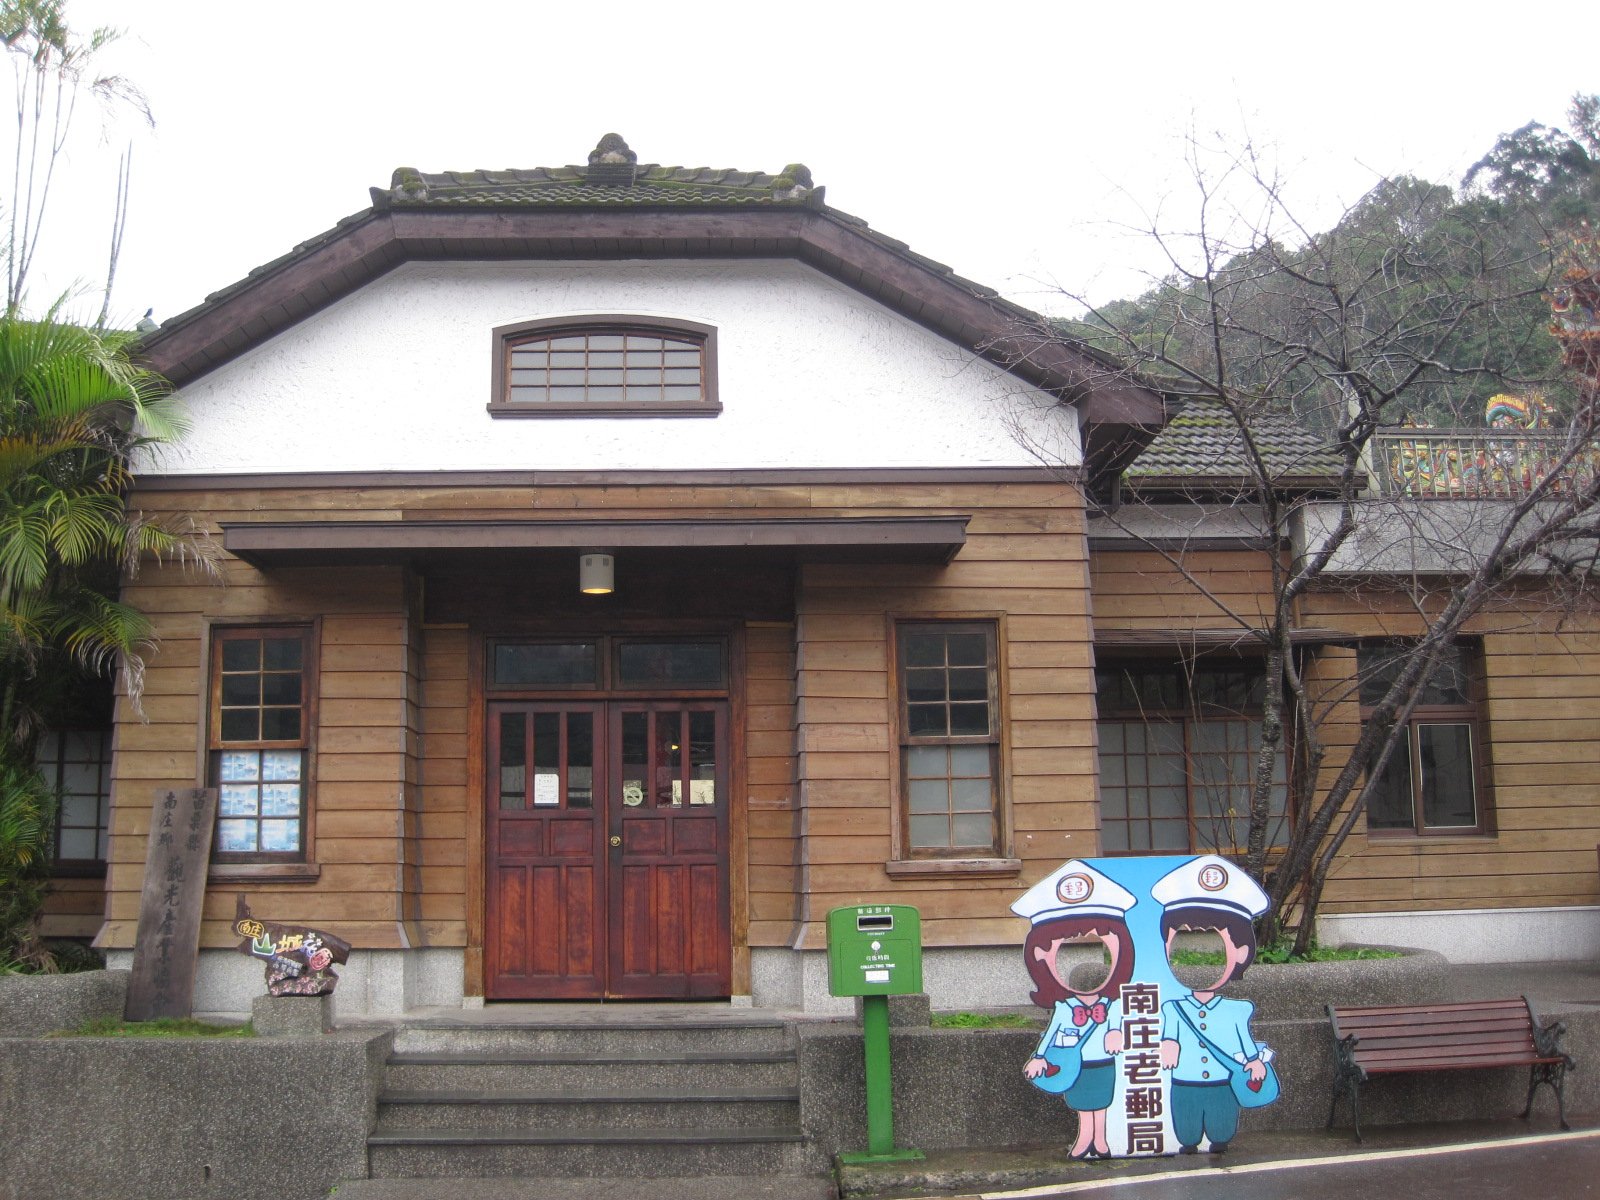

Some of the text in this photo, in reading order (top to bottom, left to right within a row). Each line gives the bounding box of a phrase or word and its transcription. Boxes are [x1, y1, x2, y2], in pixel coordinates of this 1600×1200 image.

[158, 791, 178, 851] 南庄鄉
[239, 920, 262, 938] 南庄
[1120, 982, 1164, 1155] 南庄老郵局
